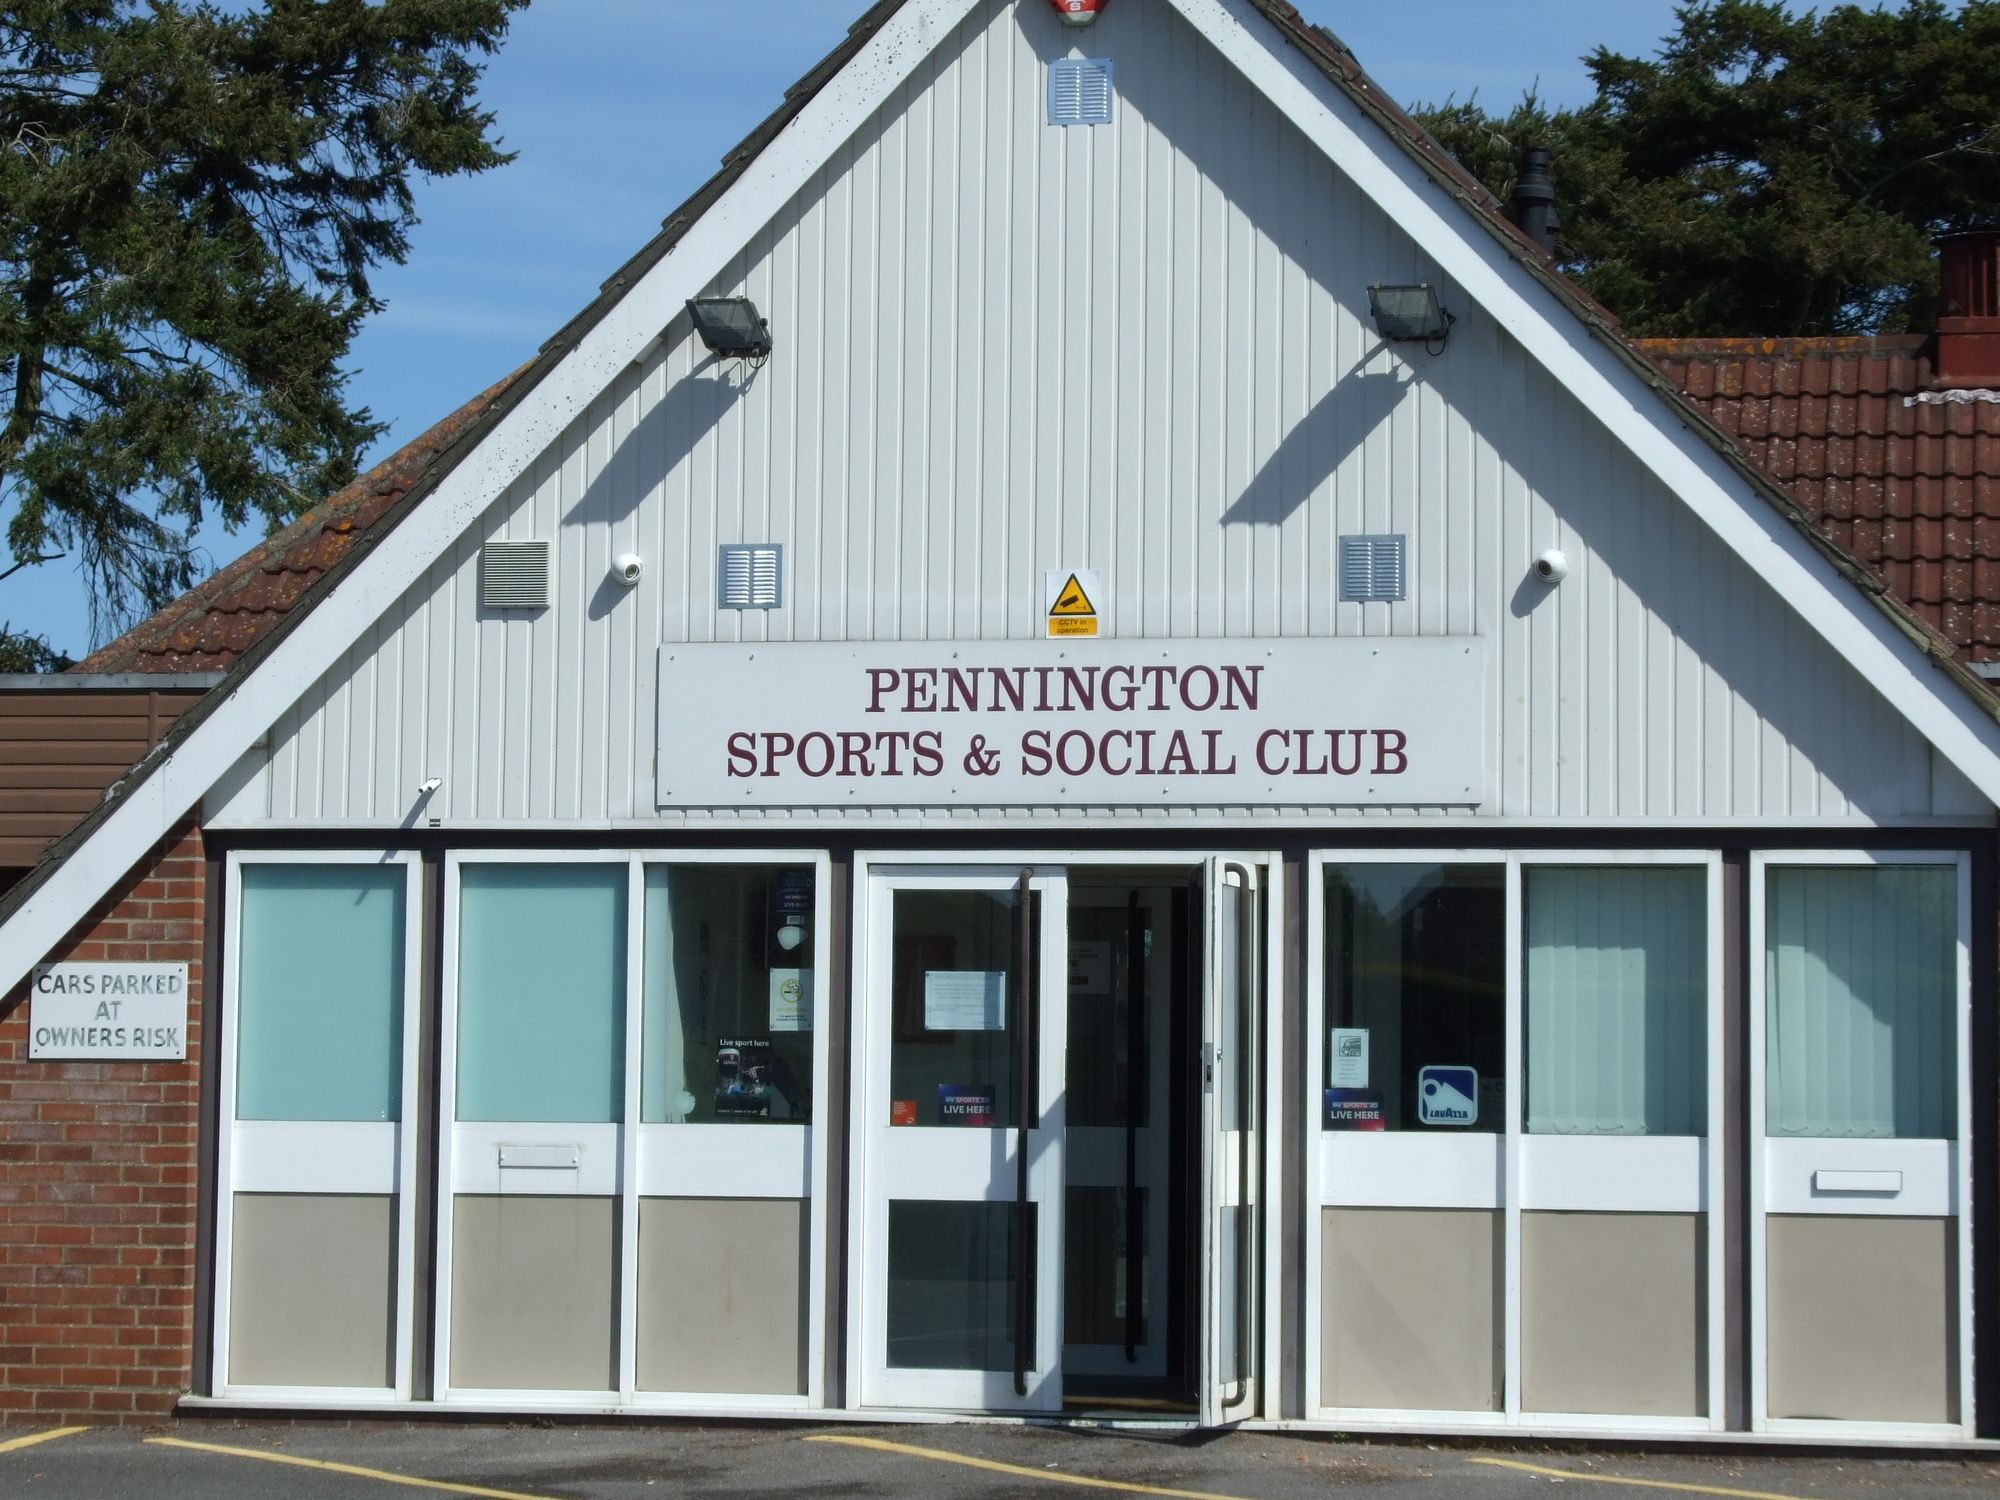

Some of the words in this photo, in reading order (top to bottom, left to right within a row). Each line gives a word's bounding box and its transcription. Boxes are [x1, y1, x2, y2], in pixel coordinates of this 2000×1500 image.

[1058, 618, 1079, 626] CCTV
[1056, 627, 1089, 635] operation
[865, 665, 1265, 713] PENNINGTON
[727, 731, 945, 778] SPORTS
[962, 732, 1001, 778] &
[1021, 729, 1238, 777] SOCIAL
[1256, 728, 1409, 776] CLUB
[37, 974, 96, 995] CARS
[101, 974, 183, 995] PARKED
[95, 1001, 123, 1021] AT
[36, 1027, 127, 1047] OWNERS
[132, 1028, 180, 1048] RISK
[719, 1038, 734, 1046] Live
[734, 1039, 753, 1048] sport
[943, 1104, 965, 1114] LIVE
[966, 1105, 991, 1115] HERE
[1330, 1110, 1353, 1119] LIVE
[1354, 1111, 1380, 1120] HERE
[1429, 1107, 1469, 1119] LAVAZZA
